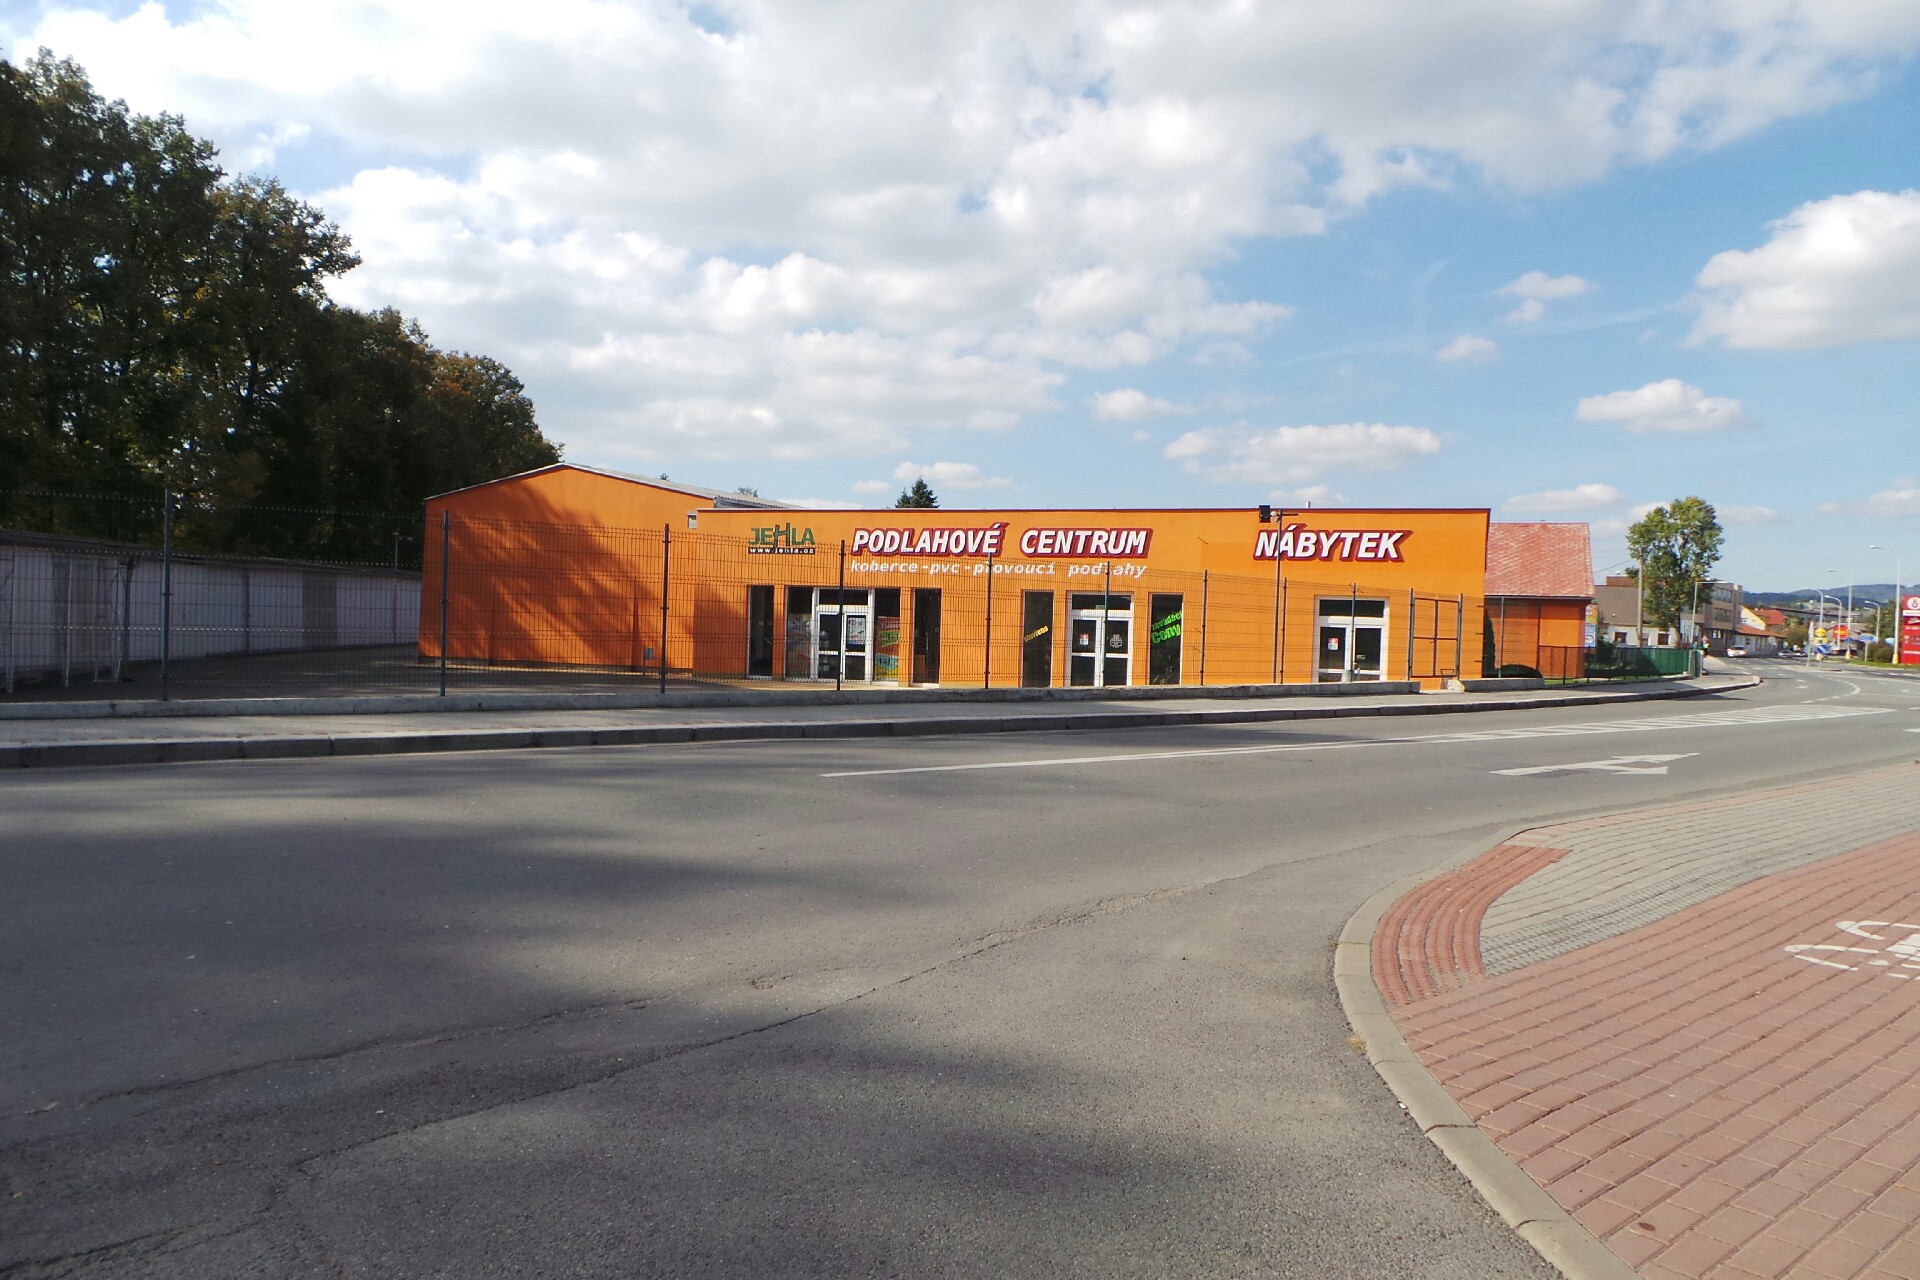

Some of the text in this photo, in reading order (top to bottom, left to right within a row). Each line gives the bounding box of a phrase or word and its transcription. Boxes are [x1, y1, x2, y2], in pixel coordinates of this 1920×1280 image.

[749, 523, 815, 547] JEHLA
[852, 523, 1149, 556] PODLAHOVÉ CENTRUM
[1254, 524, 1405, 560] NÁBYTEK
